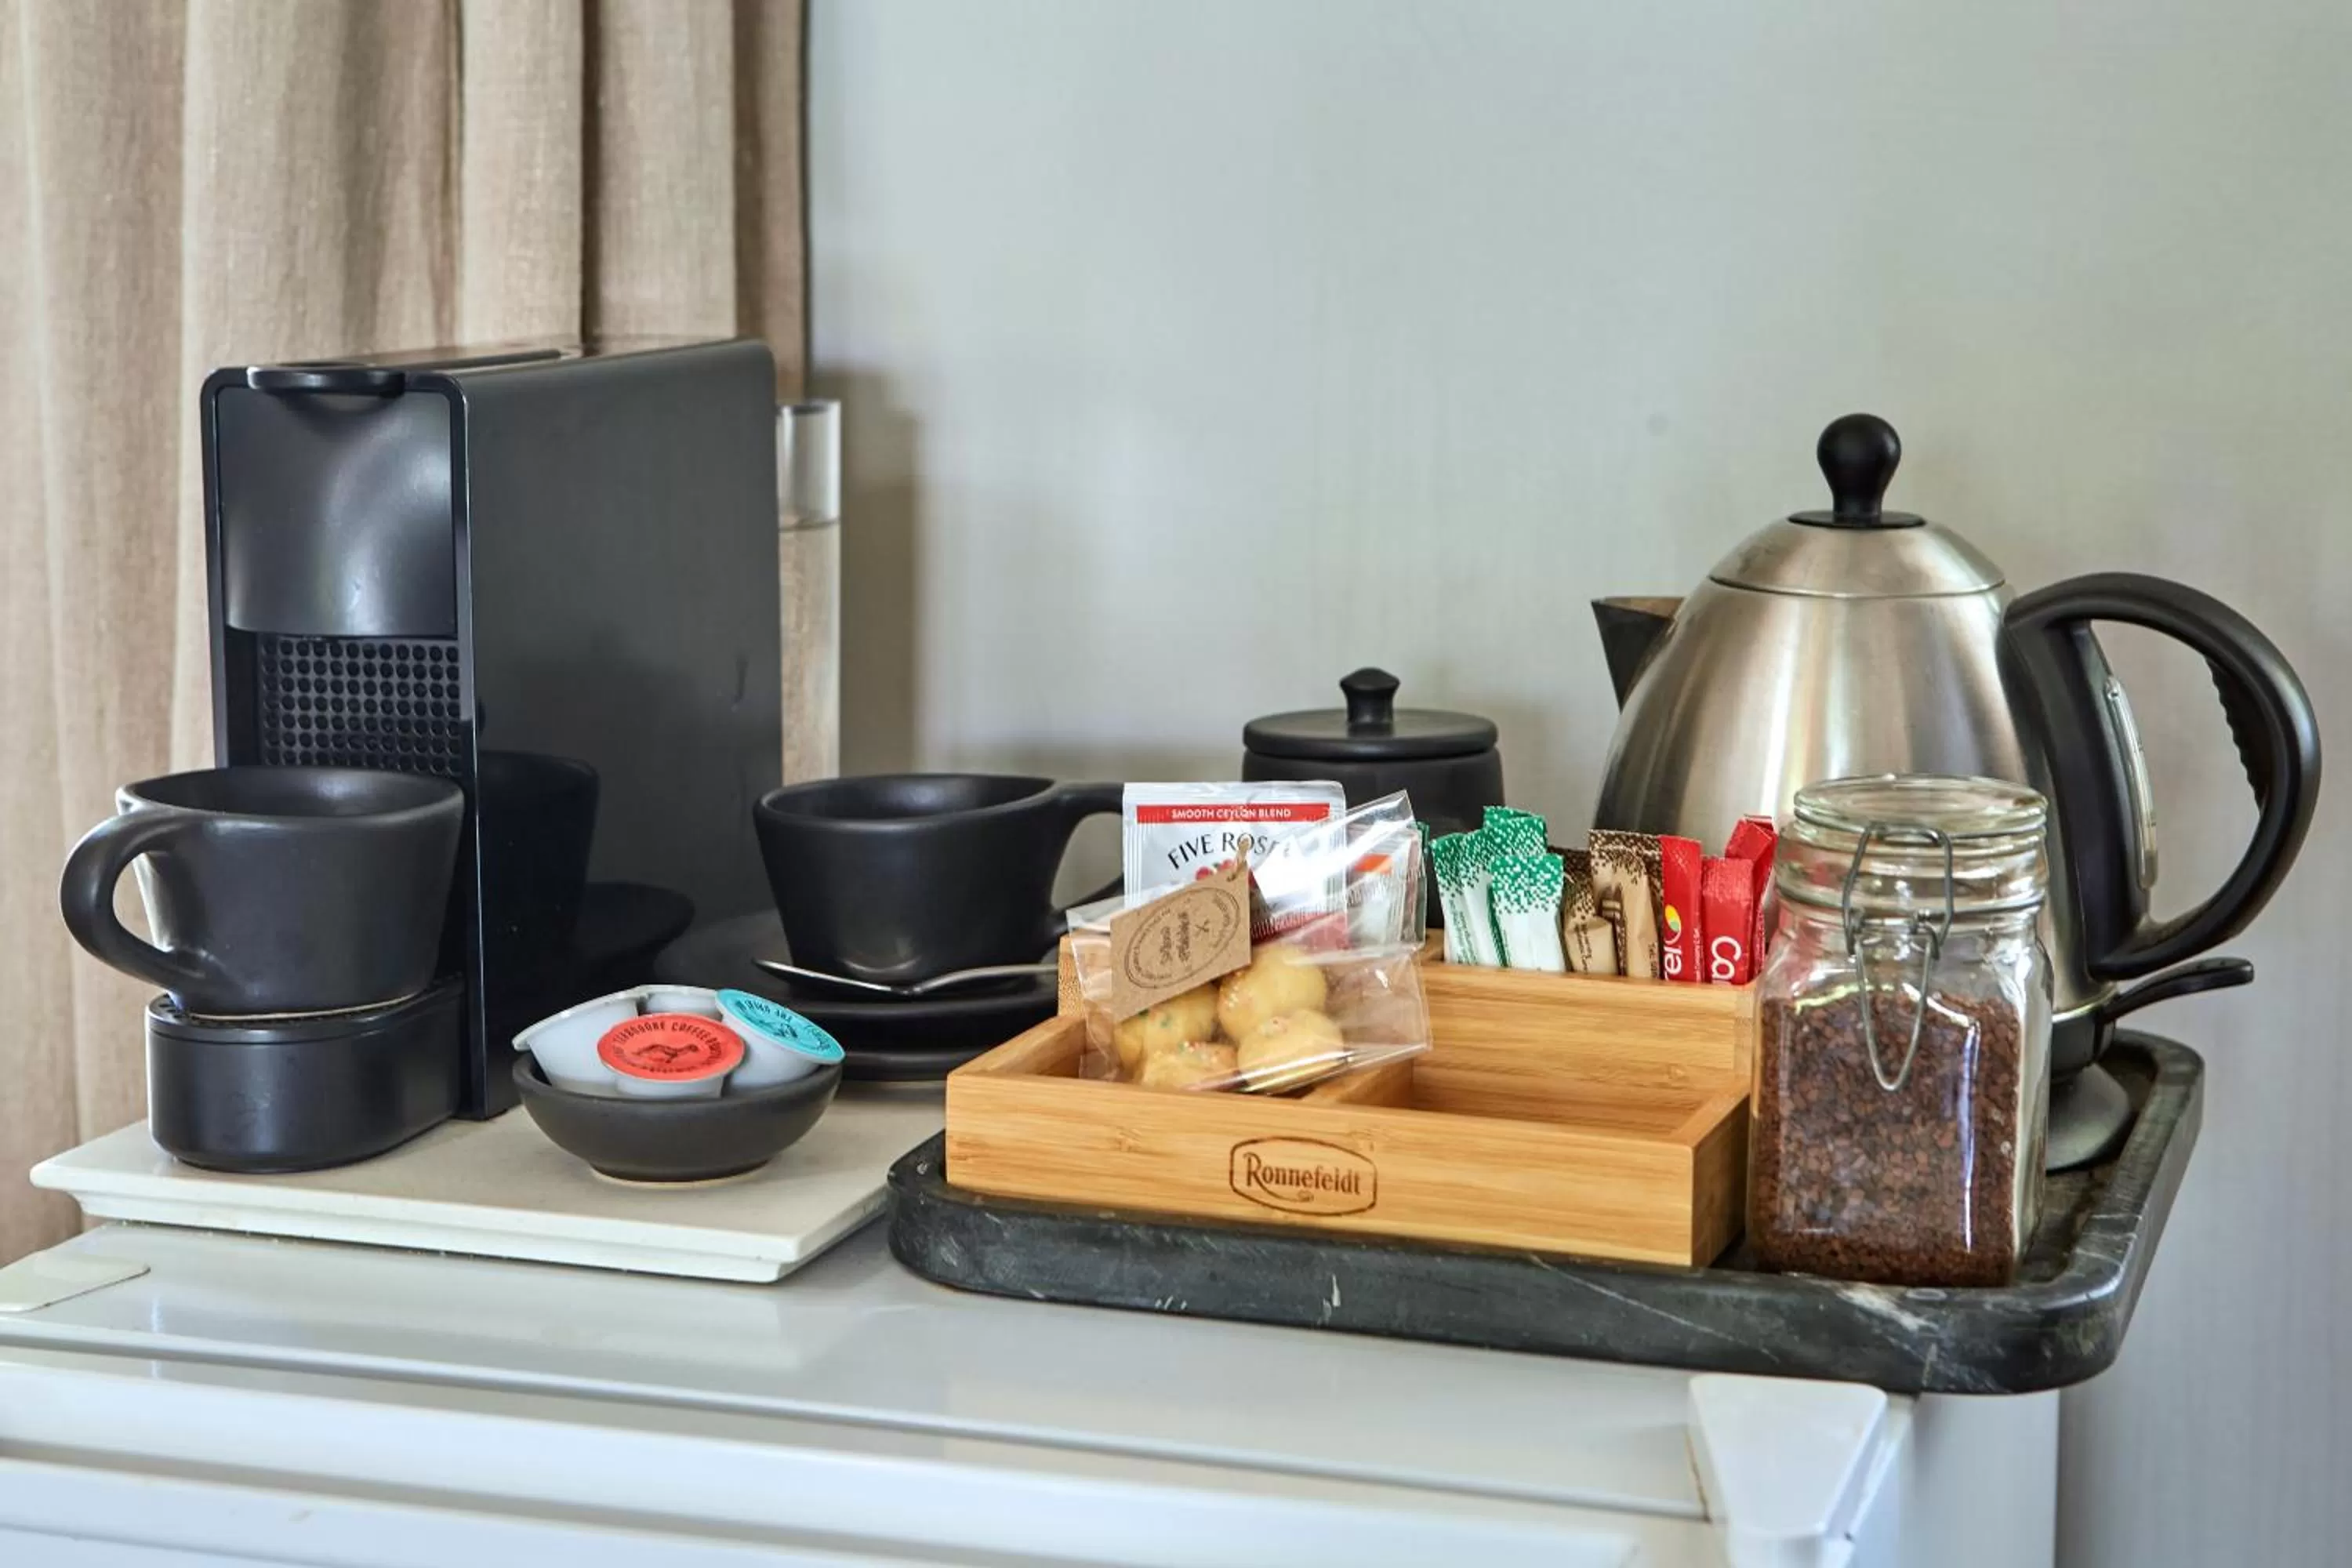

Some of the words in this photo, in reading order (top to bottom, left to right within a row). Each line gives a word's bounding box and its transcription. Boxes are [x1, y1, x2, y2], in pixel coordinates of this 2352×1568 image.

[1171, 808, 1214, 819] SMOOTH
[1216, 808, 1256, 819] CEYLON
[1258, 808, 1292, 818] BLEND
[1167, 833, 1214, 870] FIVE
